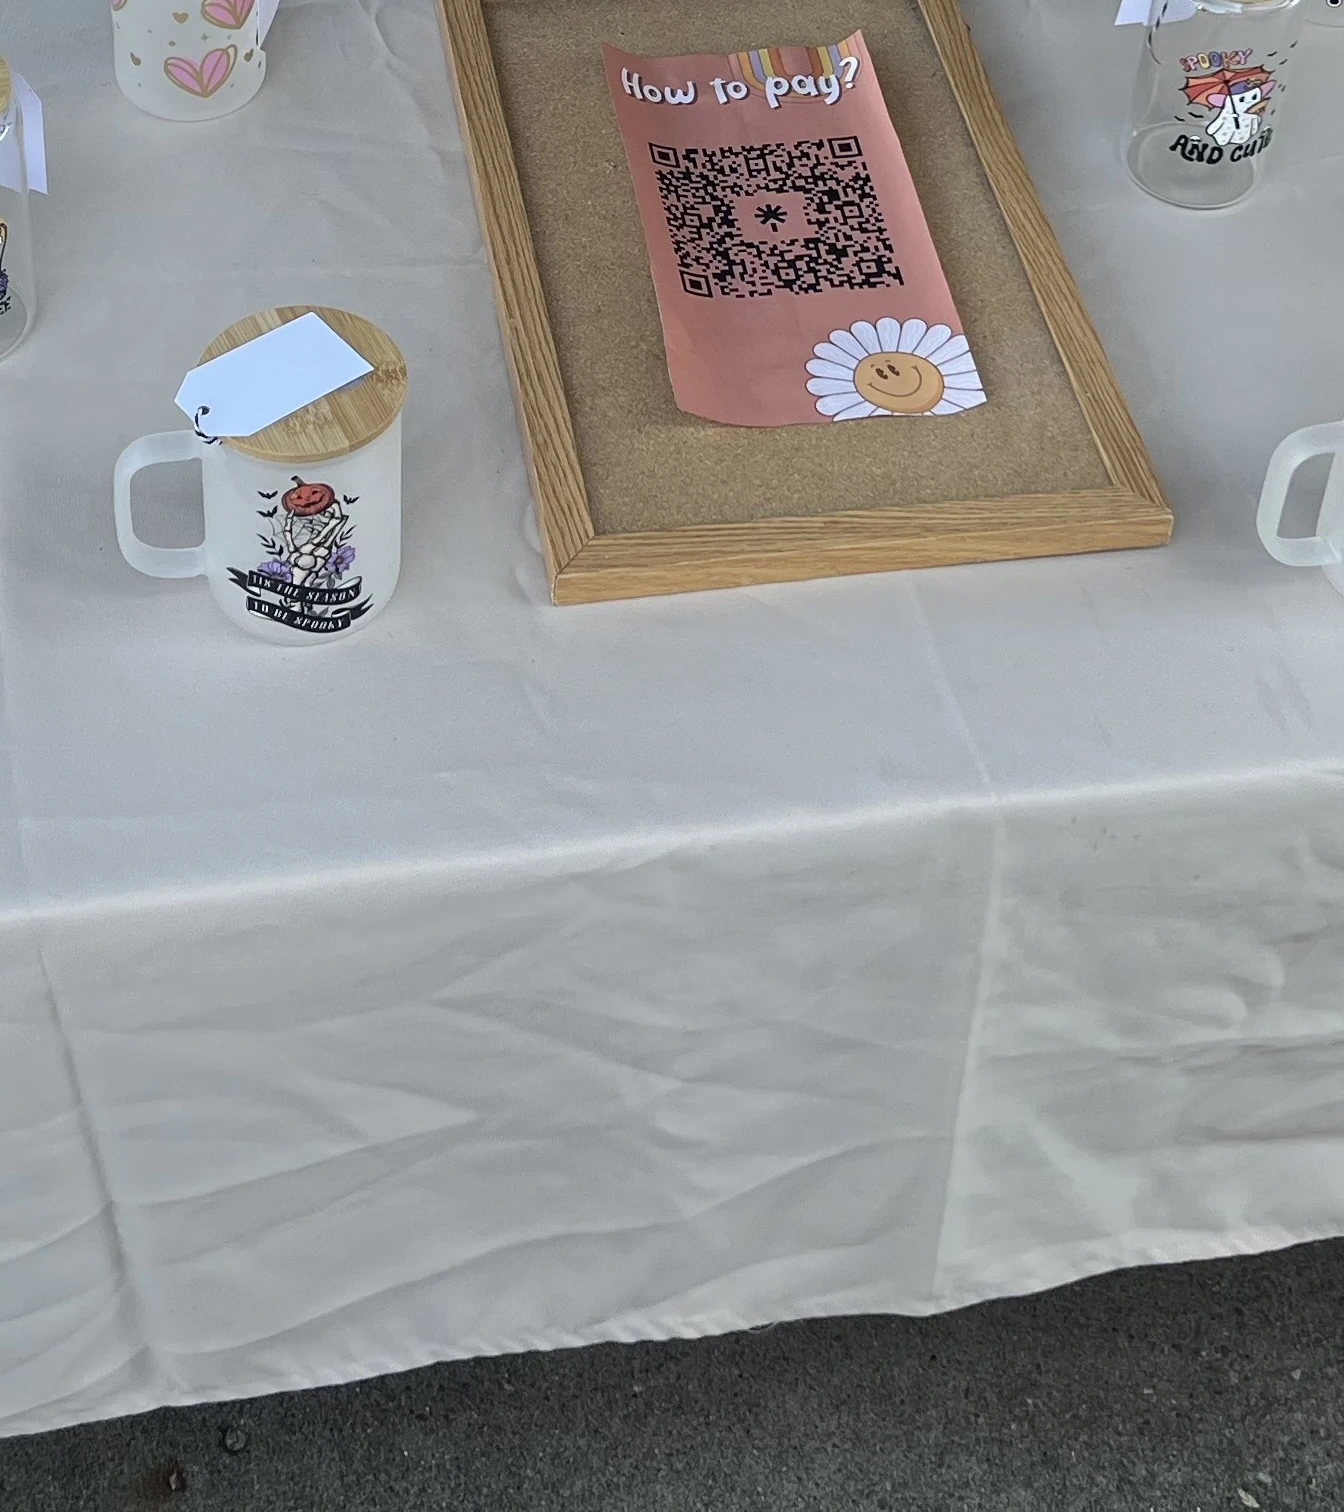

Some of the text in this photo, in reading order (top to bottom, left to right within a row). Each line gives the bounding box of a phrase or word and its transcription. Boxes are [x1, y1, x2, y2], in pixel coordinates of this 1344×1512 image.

[1179, 48, 1254, 72] SPOOKY
[621, 56, 860, 110] How to pay?
[1169, 134, 1224, 165] AND
[306, 586, 357, 604] SEASON
[254, 600, 346, 631] TO BE SPOOKY
